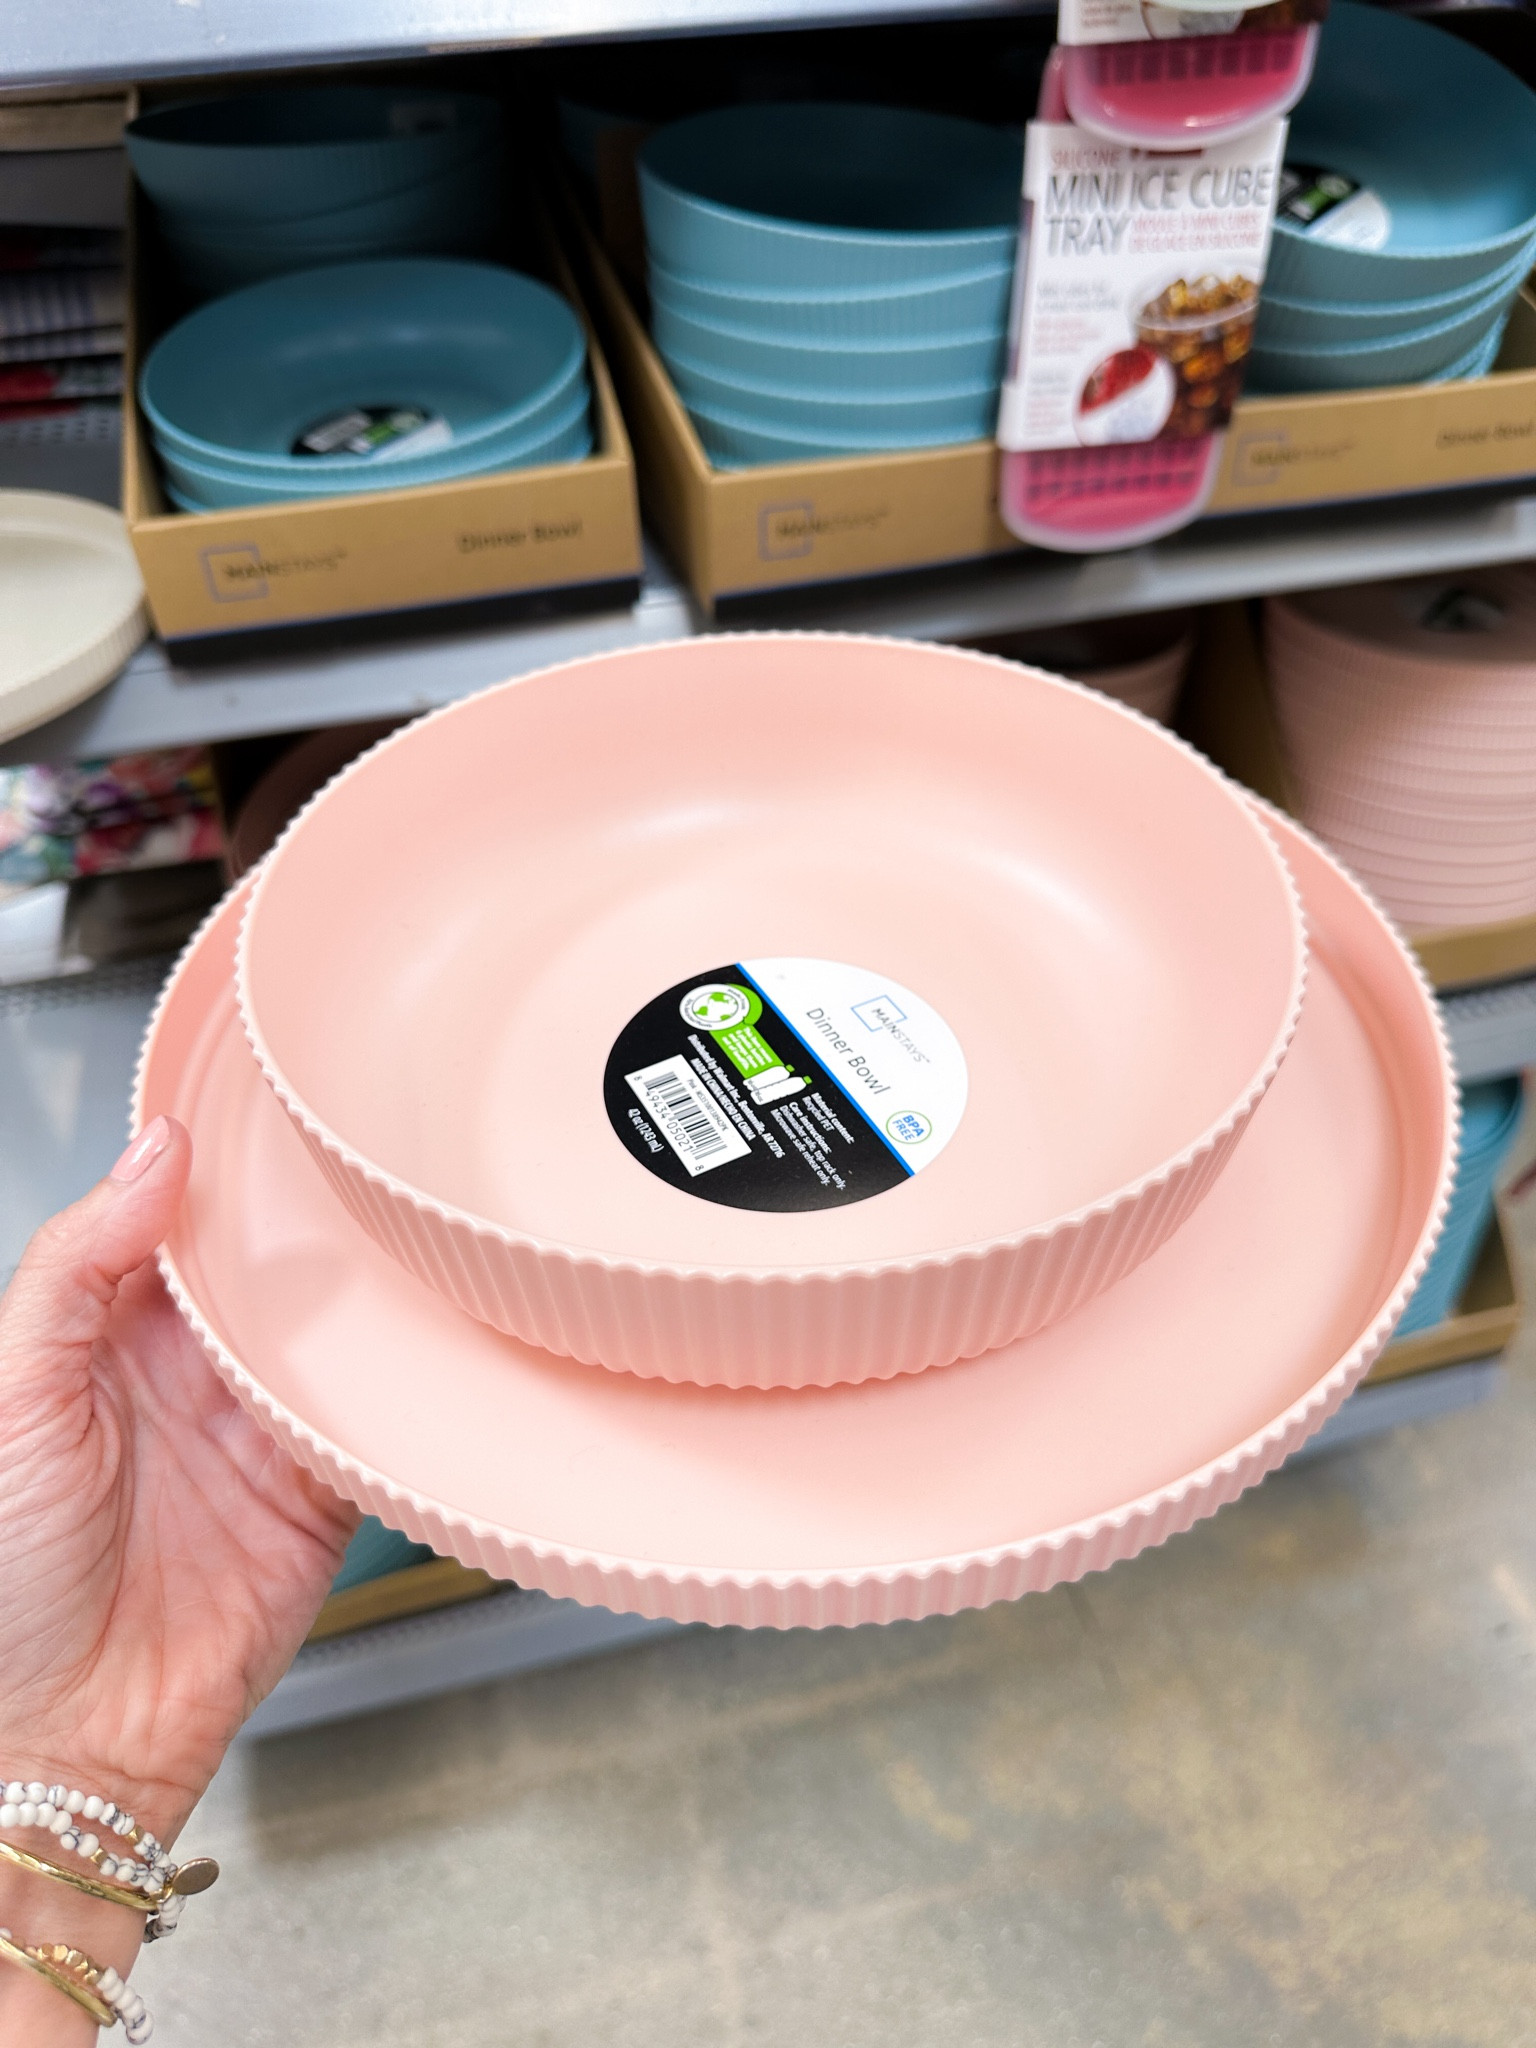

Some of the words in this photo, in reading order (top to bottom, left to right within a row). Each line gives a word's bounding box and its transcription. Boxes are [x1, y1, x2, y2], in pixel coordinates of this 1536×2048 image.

[1046, 172, 1124, 214] MINI
[1127, 166, 1182, 211] ICE
[1188, 164, 1276, 208] CUBE
[1044, 214, 1130, 256] TRAY
[457, 533, 527, 555] Dinner
[531, 516, 583, 544] Bowl
[687, 1034, 715, 1063] Distributed
[806, 1008, 853, 1053] Dinner
[848, 1056, 890, 1094] Bowl
[690, 1058, 708, 1075] MADE
[701, 1072, 713, 1081] IN
[707, 1060, 718, 1070] by
[711, 1066, 735, 1091] Walmart
[628, 1108, 641, 1118] 42
[632, 1116, 643, 1125] oz
[646, 1088, 670, 1119] 49434
[666, 1122, 694, 1152] 05021
[731, 1113, 744, 1123] EN
[736, 1100, 765, 1135] Bentonville,
[802, 1096, 826, 1121] Recycled
[820, 1119, 835, 1131] PET
[811, 1092, 837, 1119] Material
[831, 1118, 854, 1144] content:
[636, 1122, 656, 1141] (1243
[737, 1121, 756, 1141] CHINA
[789, 1102, 803, 1117] Care
[799, 1115, 832, 1154] instructions:
[893, 1119, 915, 1141] FREE
[903, 1115, 924, 1136] BPA
[648, 1139, 664, 1153] mL)
[761, 1133, 774, 1143] AR
[767, 1140, 785, 1158] 72716
[770, 1108, 796, 1140] Microwave
[792, 1139, 806, 1152] safe
[802, 1151, 821, 1171] reheat
[816, 1170, 830, 1186] only.
[779, 1105, 807, 1137] Dishwasher
[803, 1136, 816, 1152] safe,
[814, 1150, 825, 1162] top
[822, 1161, 836, 1175] rack
[832, 1174, 846, 1190] only.
